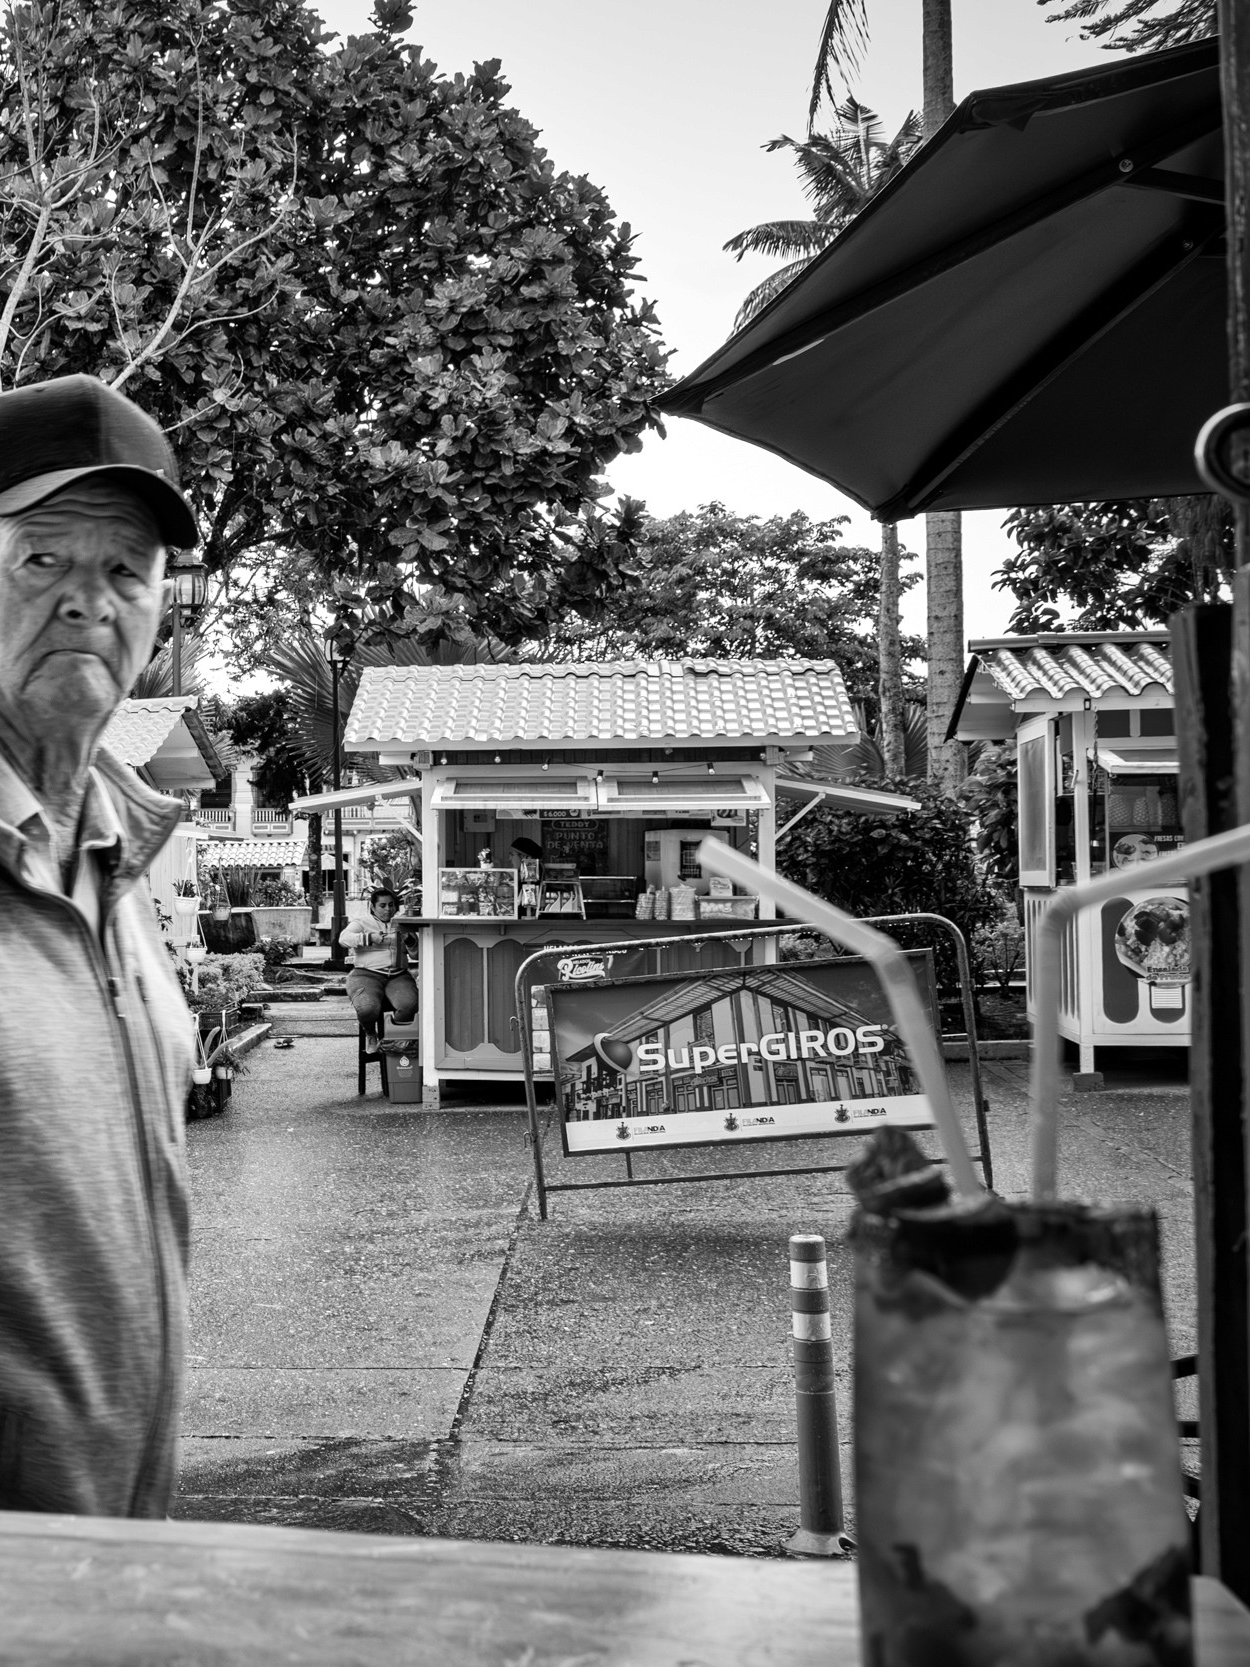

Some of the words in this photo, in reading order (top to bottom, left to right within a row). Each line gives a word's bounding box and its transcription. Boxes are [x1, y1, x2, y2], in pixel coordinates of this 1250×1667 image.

[554, 831, 596, 840] PUNTO
[547, 841, 561, 849] DE
[566, 841, 604, 849] VENTA
[637, 1025, 885, 1074] SuperGIROS
